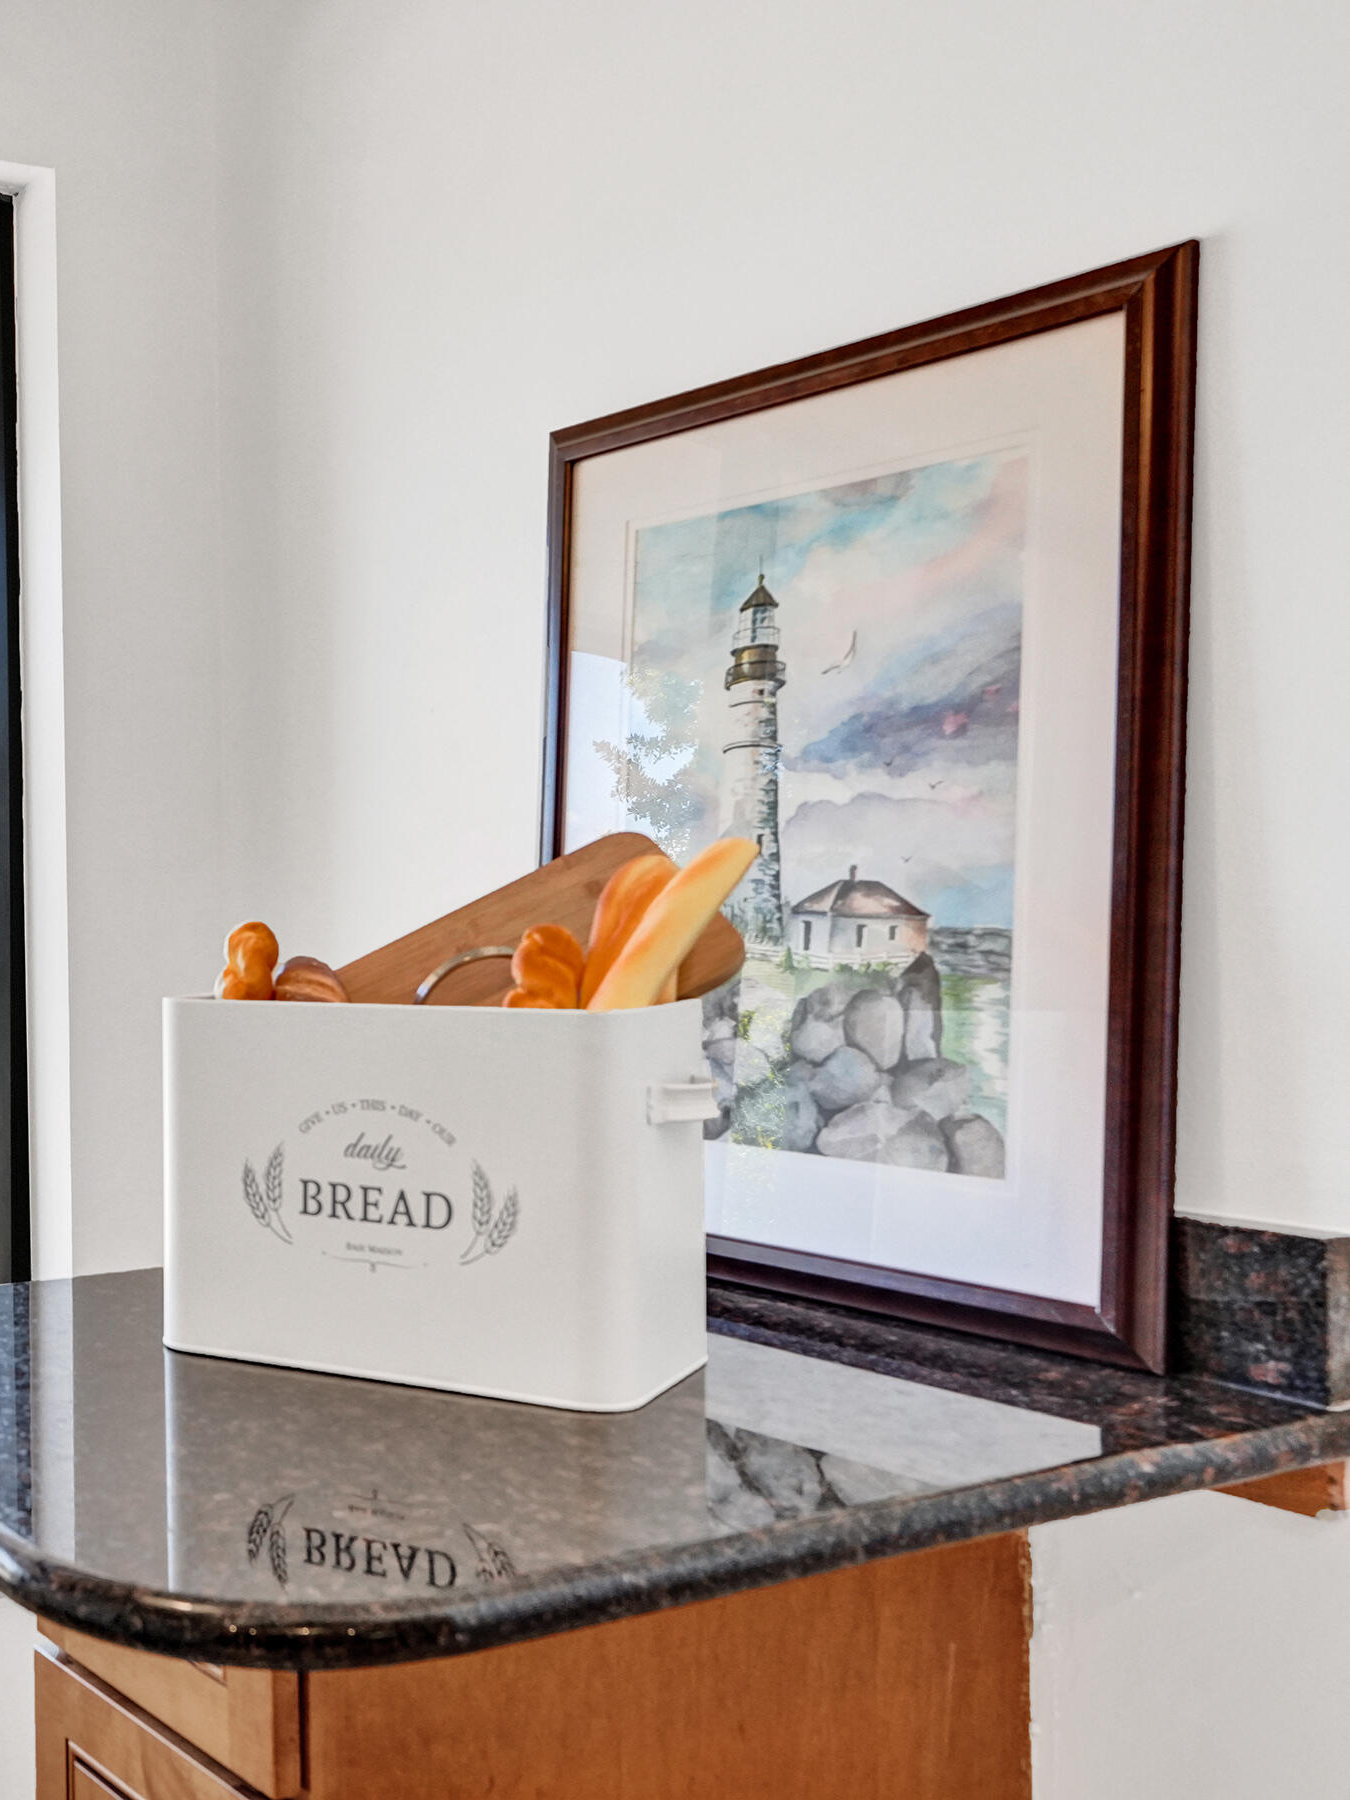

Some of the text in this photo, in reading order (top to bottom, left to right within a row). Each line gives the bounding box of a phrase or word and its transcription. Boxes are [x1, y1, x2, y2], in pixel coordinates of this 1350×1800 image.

[298, 1098, 457, 1147] GIVE US THIS DAY OUR
[343, 1131, 407, 1171] daily
[299, 1178, 454, 1231] BREAD
